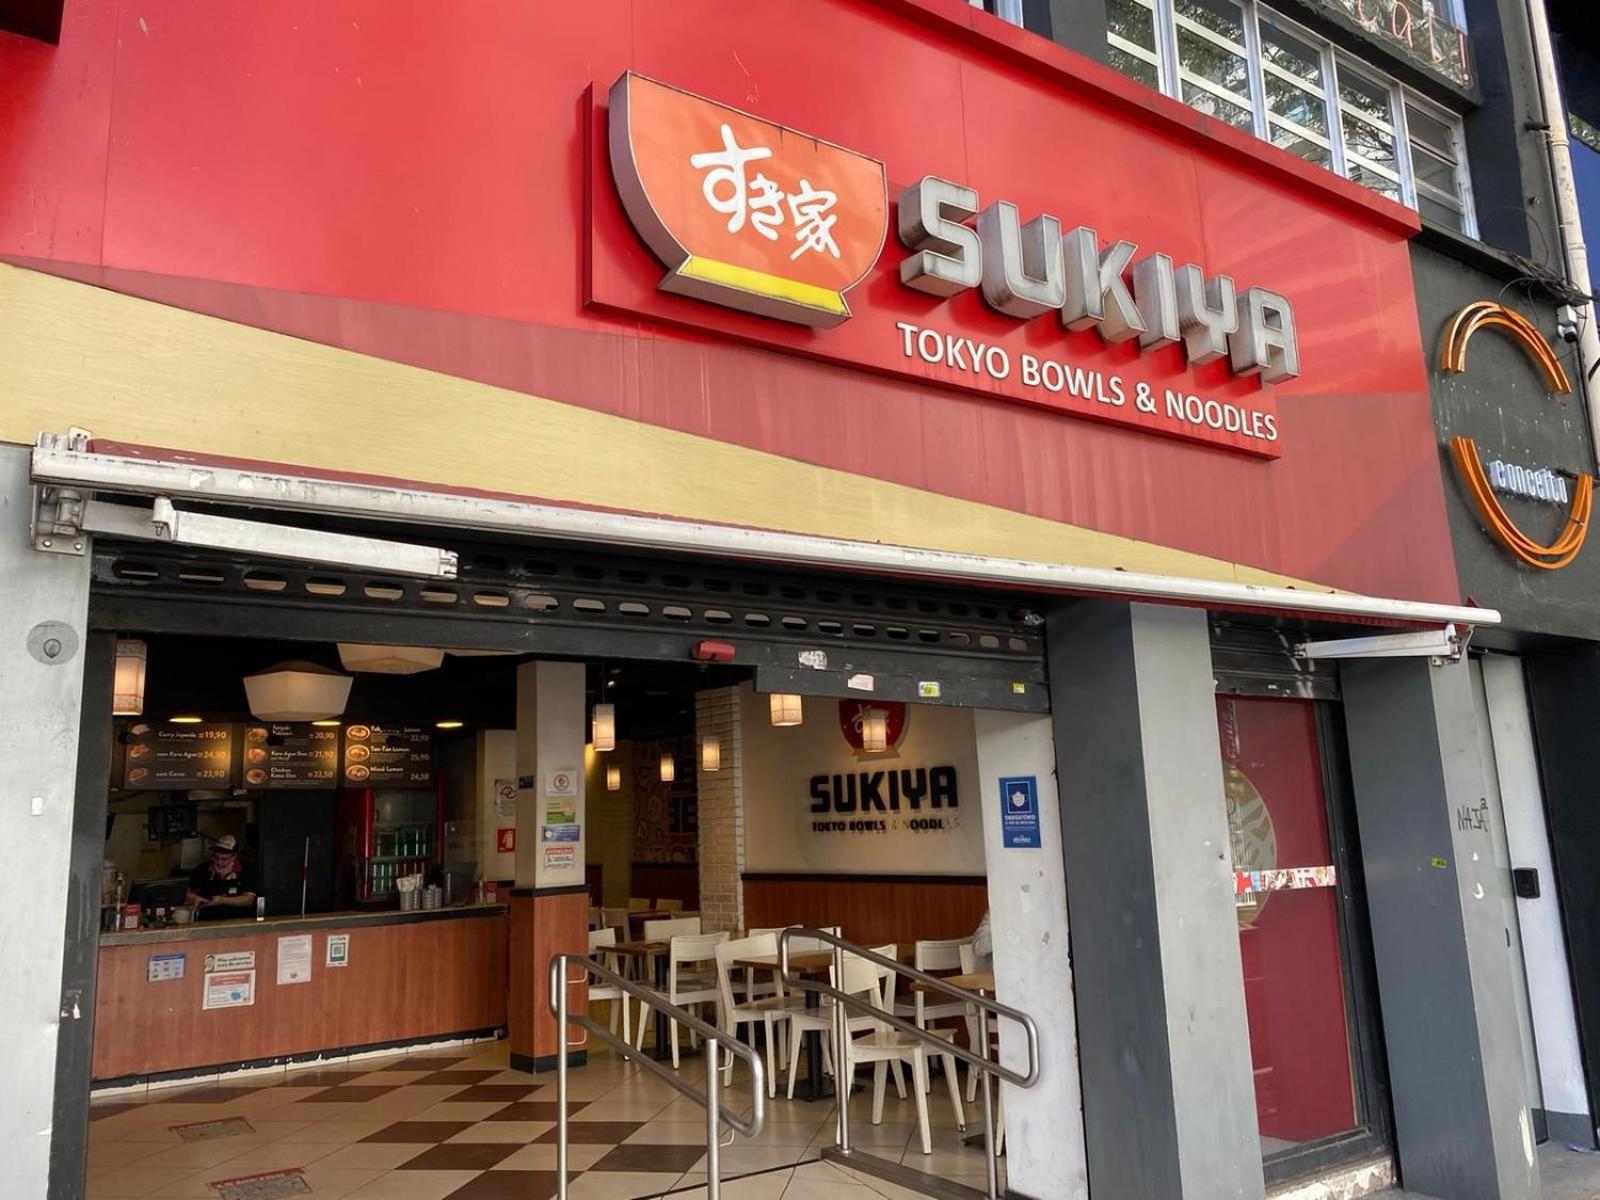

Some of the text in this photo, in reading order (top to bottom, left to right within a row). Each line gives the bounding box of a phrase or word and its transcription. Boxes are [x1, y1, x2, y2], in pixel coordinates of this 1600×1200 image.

[690, 124, 841, 261] すき家
[899, 175, 1301, 383] SUKIYA
[897, 322, 1278, 441] TOKYO BOWLS & NOODLES
[810, 766, 959, 813] SUKIYA
[812, 819, 846, 832] TOKYO
[849, 818, 886, 831] BOWLS
